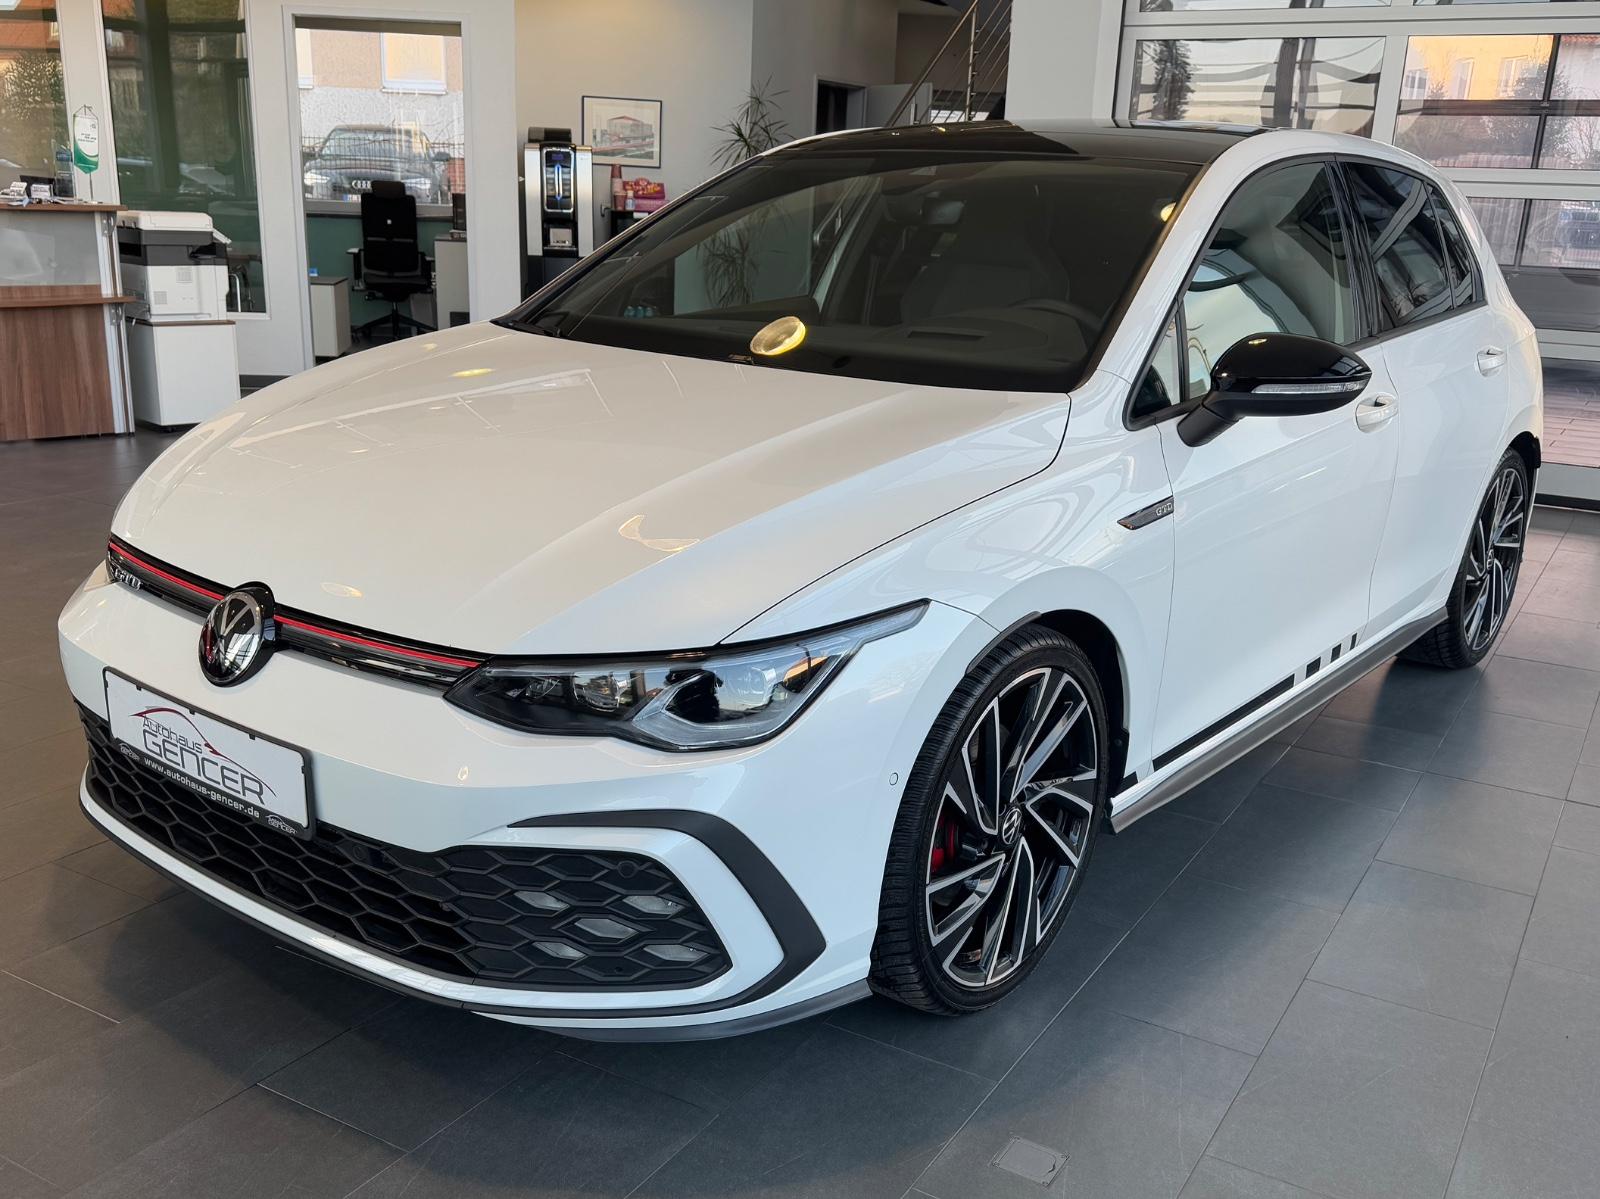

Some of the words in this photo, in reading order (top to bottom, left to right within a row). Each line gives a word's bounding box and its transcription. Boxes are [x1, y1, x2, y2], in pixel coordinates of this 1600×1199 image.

[1156, 502, 1172, 515] GTD
[143, 715, 203, 754] Autohaus
[144, 757, 260, 818] www.autohaus-gencer.de
